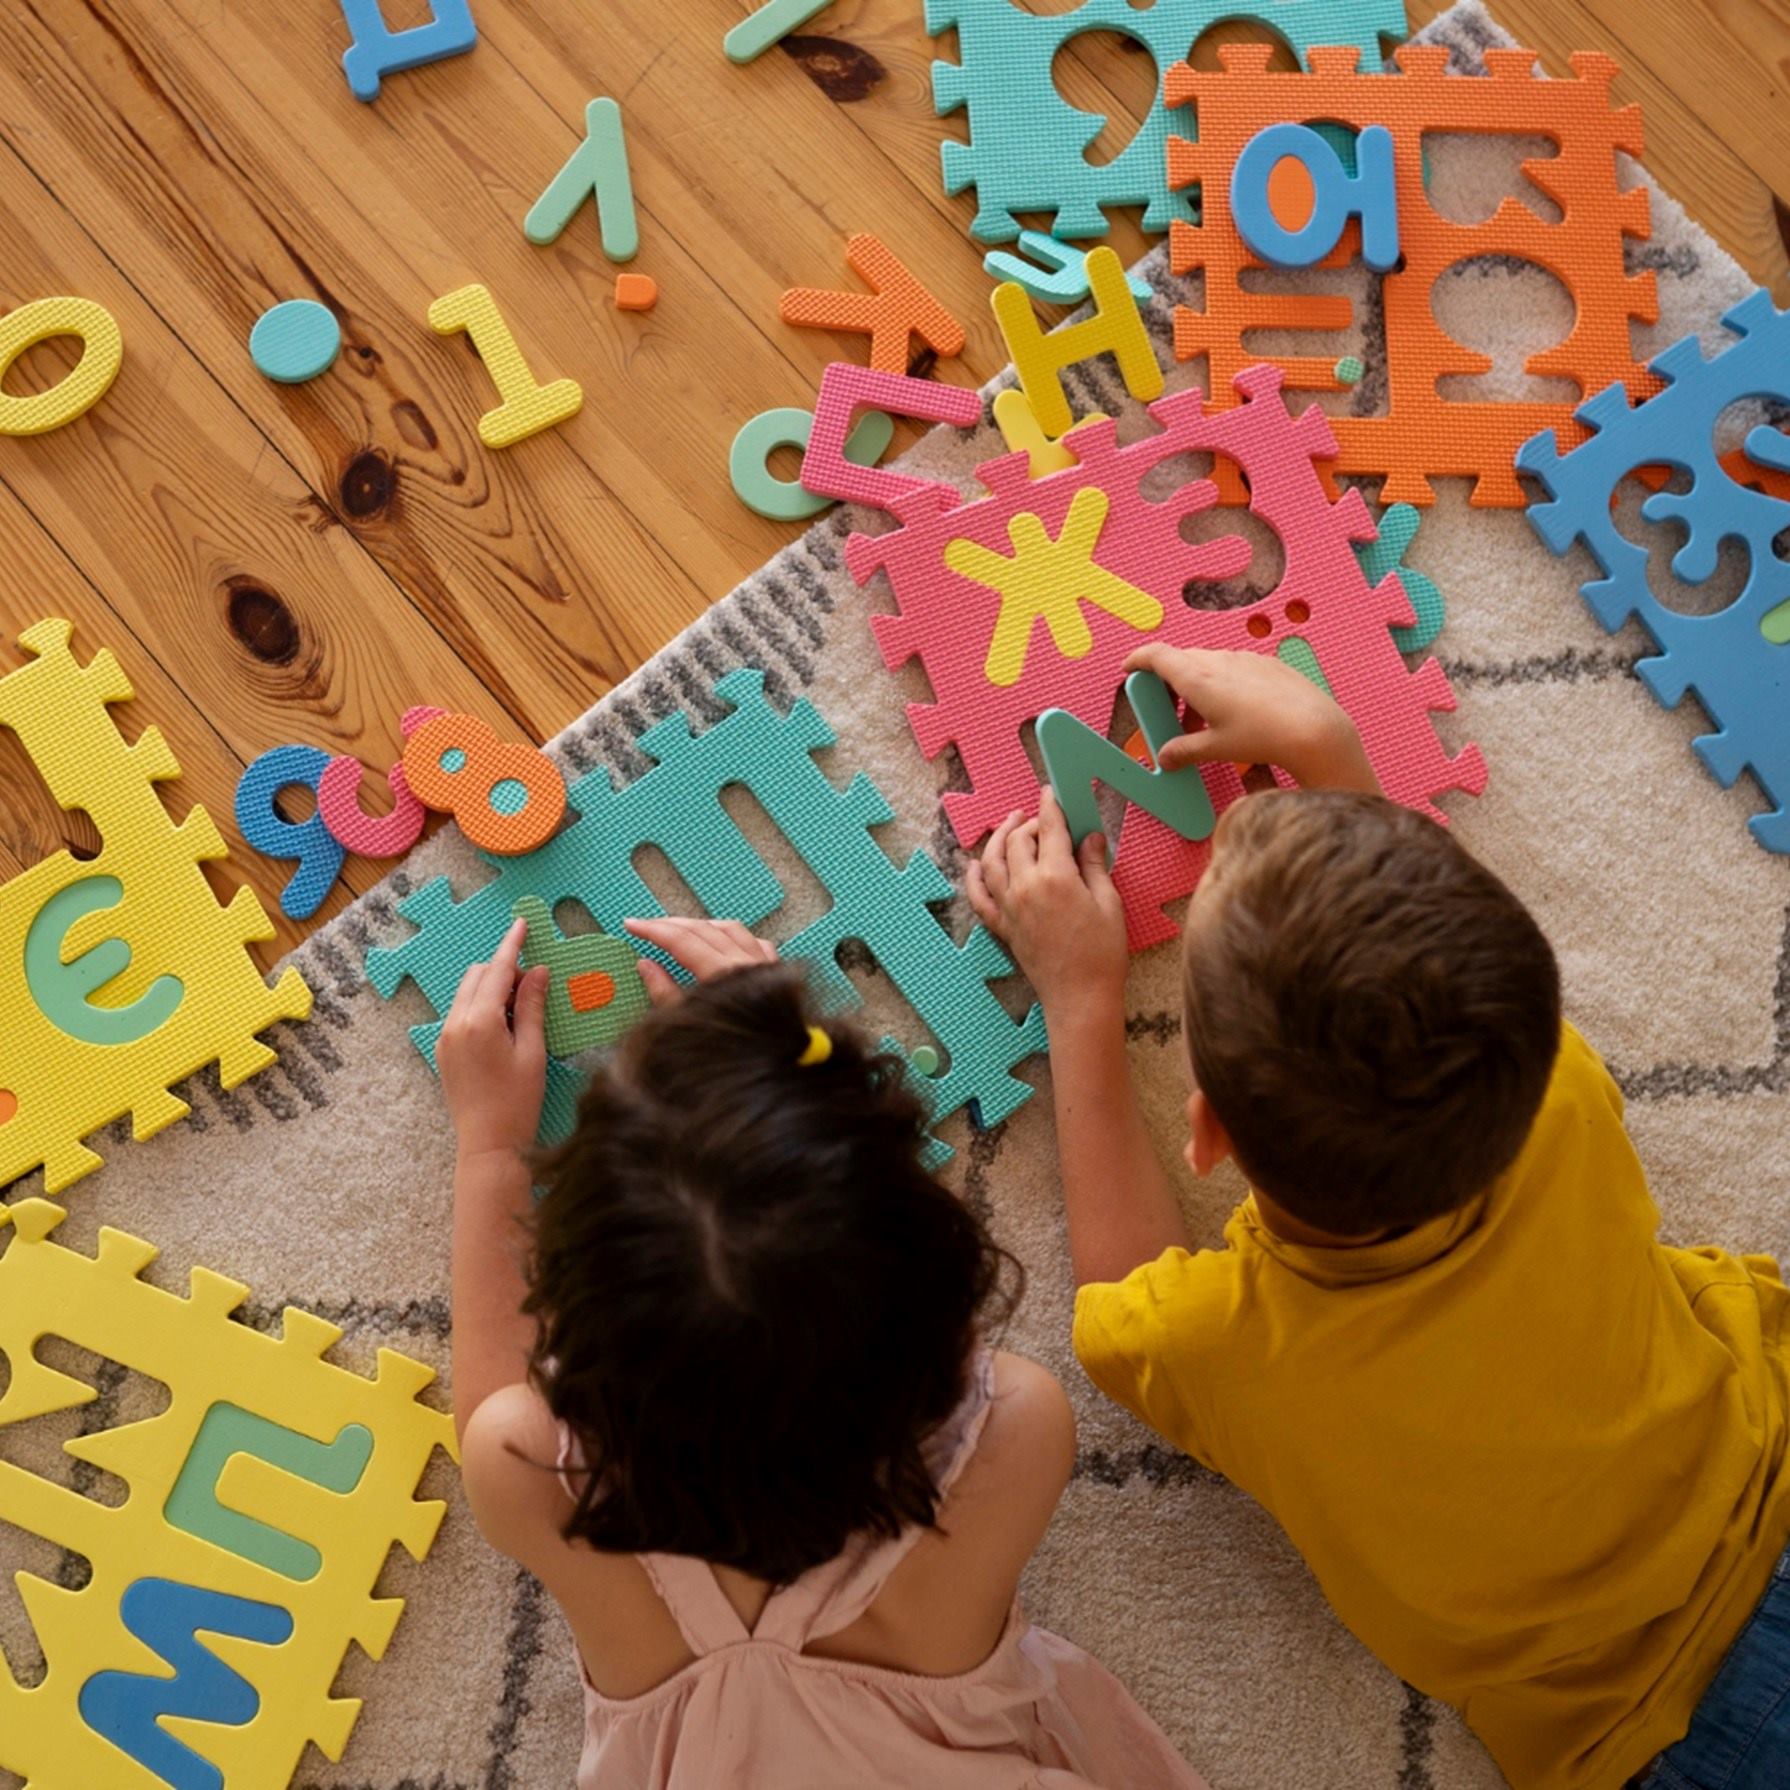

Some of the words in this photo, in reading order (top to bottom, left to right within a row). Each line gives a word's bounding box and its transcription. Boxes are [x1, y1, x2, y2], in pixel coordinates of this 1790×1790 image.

[428, 284, 583, 449] 1
[234, 743, 348, 921] 9
[402, 713, 566, 857] 8
